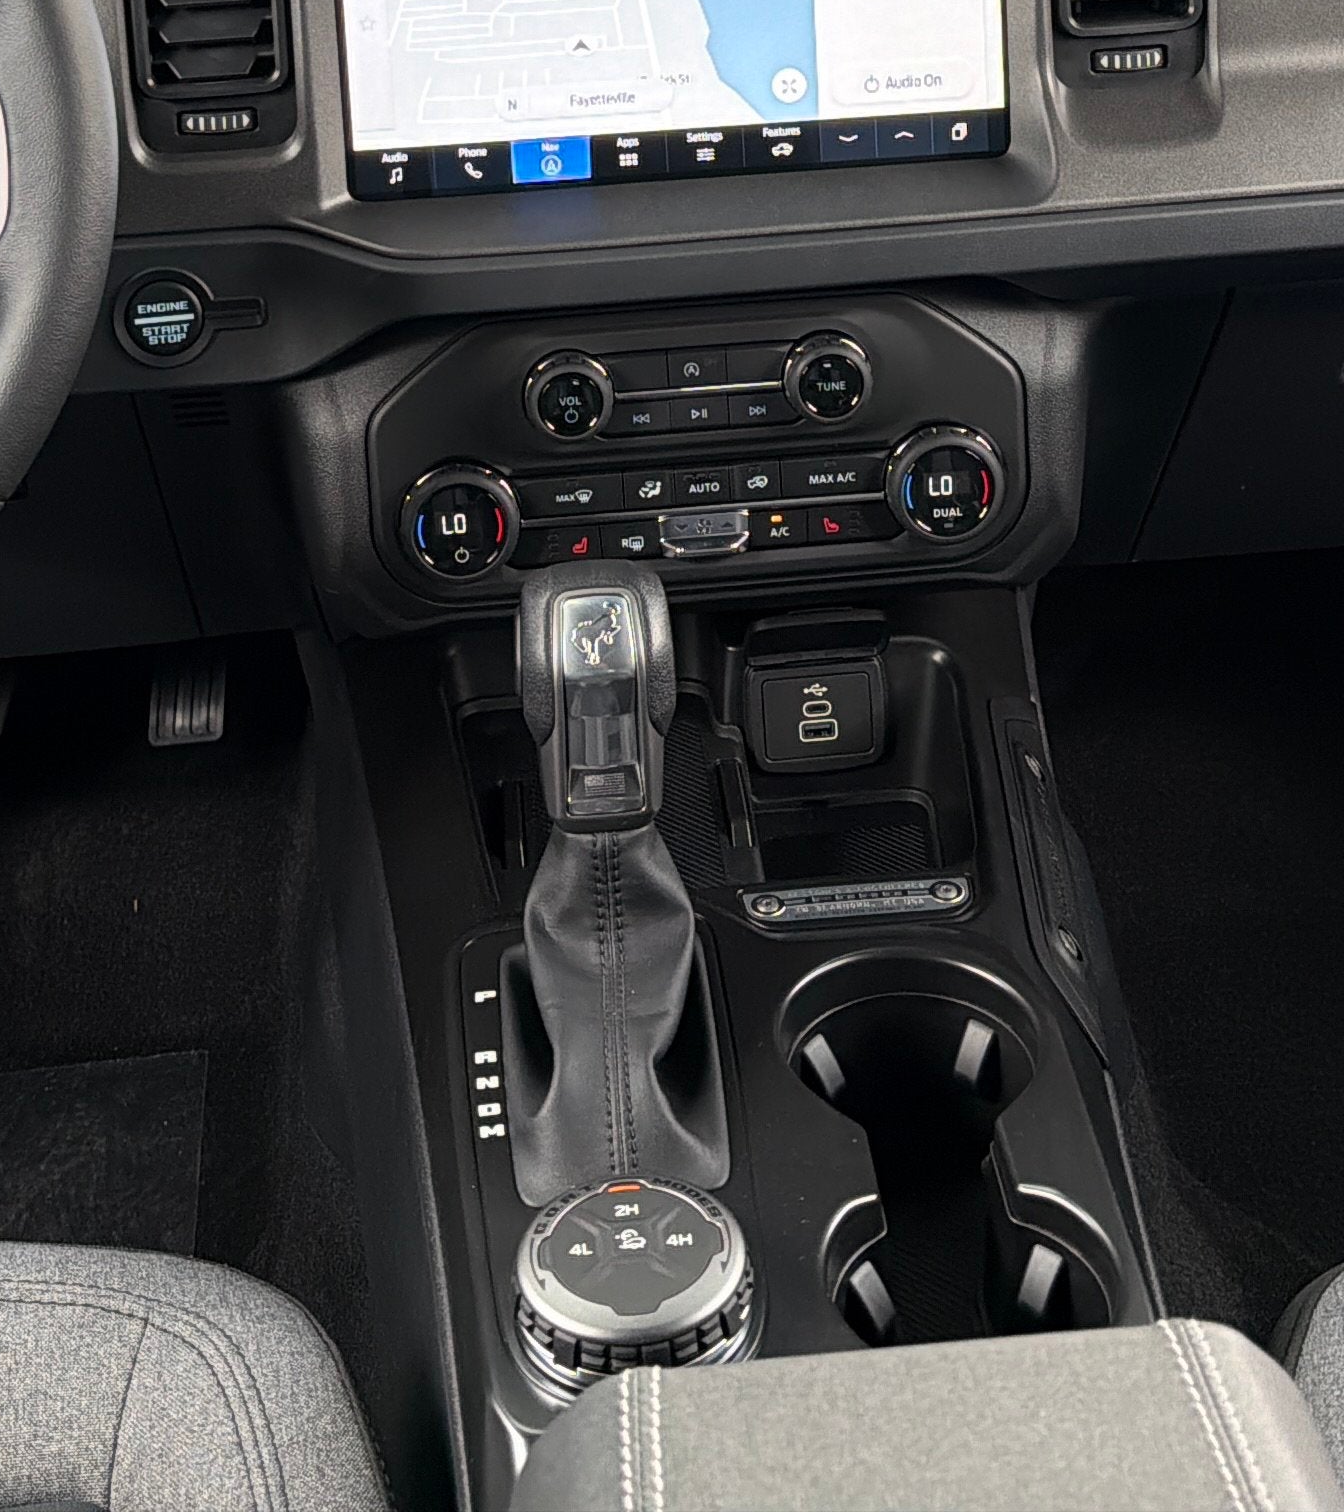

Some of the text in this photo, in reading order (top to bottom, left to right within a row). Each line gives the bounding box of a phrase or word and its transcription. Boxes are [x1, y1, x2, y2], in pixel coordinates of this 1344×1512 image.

[885, 73, 943, 90] Audio On
[686, 132, 724, 144] Settings
[762, 126, 801, 139] Features
[616, 137, 640, 149] Apps
[381, 152, 408, 164] Audio
[458, 147, 487, 159] Phone
[137, 300, 189, 314] ENGINE
[142, 323, 190, 336] START
[148, 334, 187, 345] STOP
[816, 380, 847, 393] TUNE
[558, 396, 582, 408] VOL
[809, 470, 856, 485] MAX A/C
[689, 481, 720, 494] AUTO
[556, 493, 575, 503] MAX
[932, 506, 963, 519] DUAL
[770, 525, 791, 537] A/C
[474, 990, 497, 1003] P
[474, 1050, 498, 1065] R
[476, 1075, 499, 1090] N
[477, 1102, 502, 1117] D
[479, 1123, 505, 1138] M
[653, 1177, 723, 1218] MODES
[613, 1203, 640, 1218] 2H
[665, 1233, 693, 1247] 4H
[568, 1242, 594, 1257] 4L
